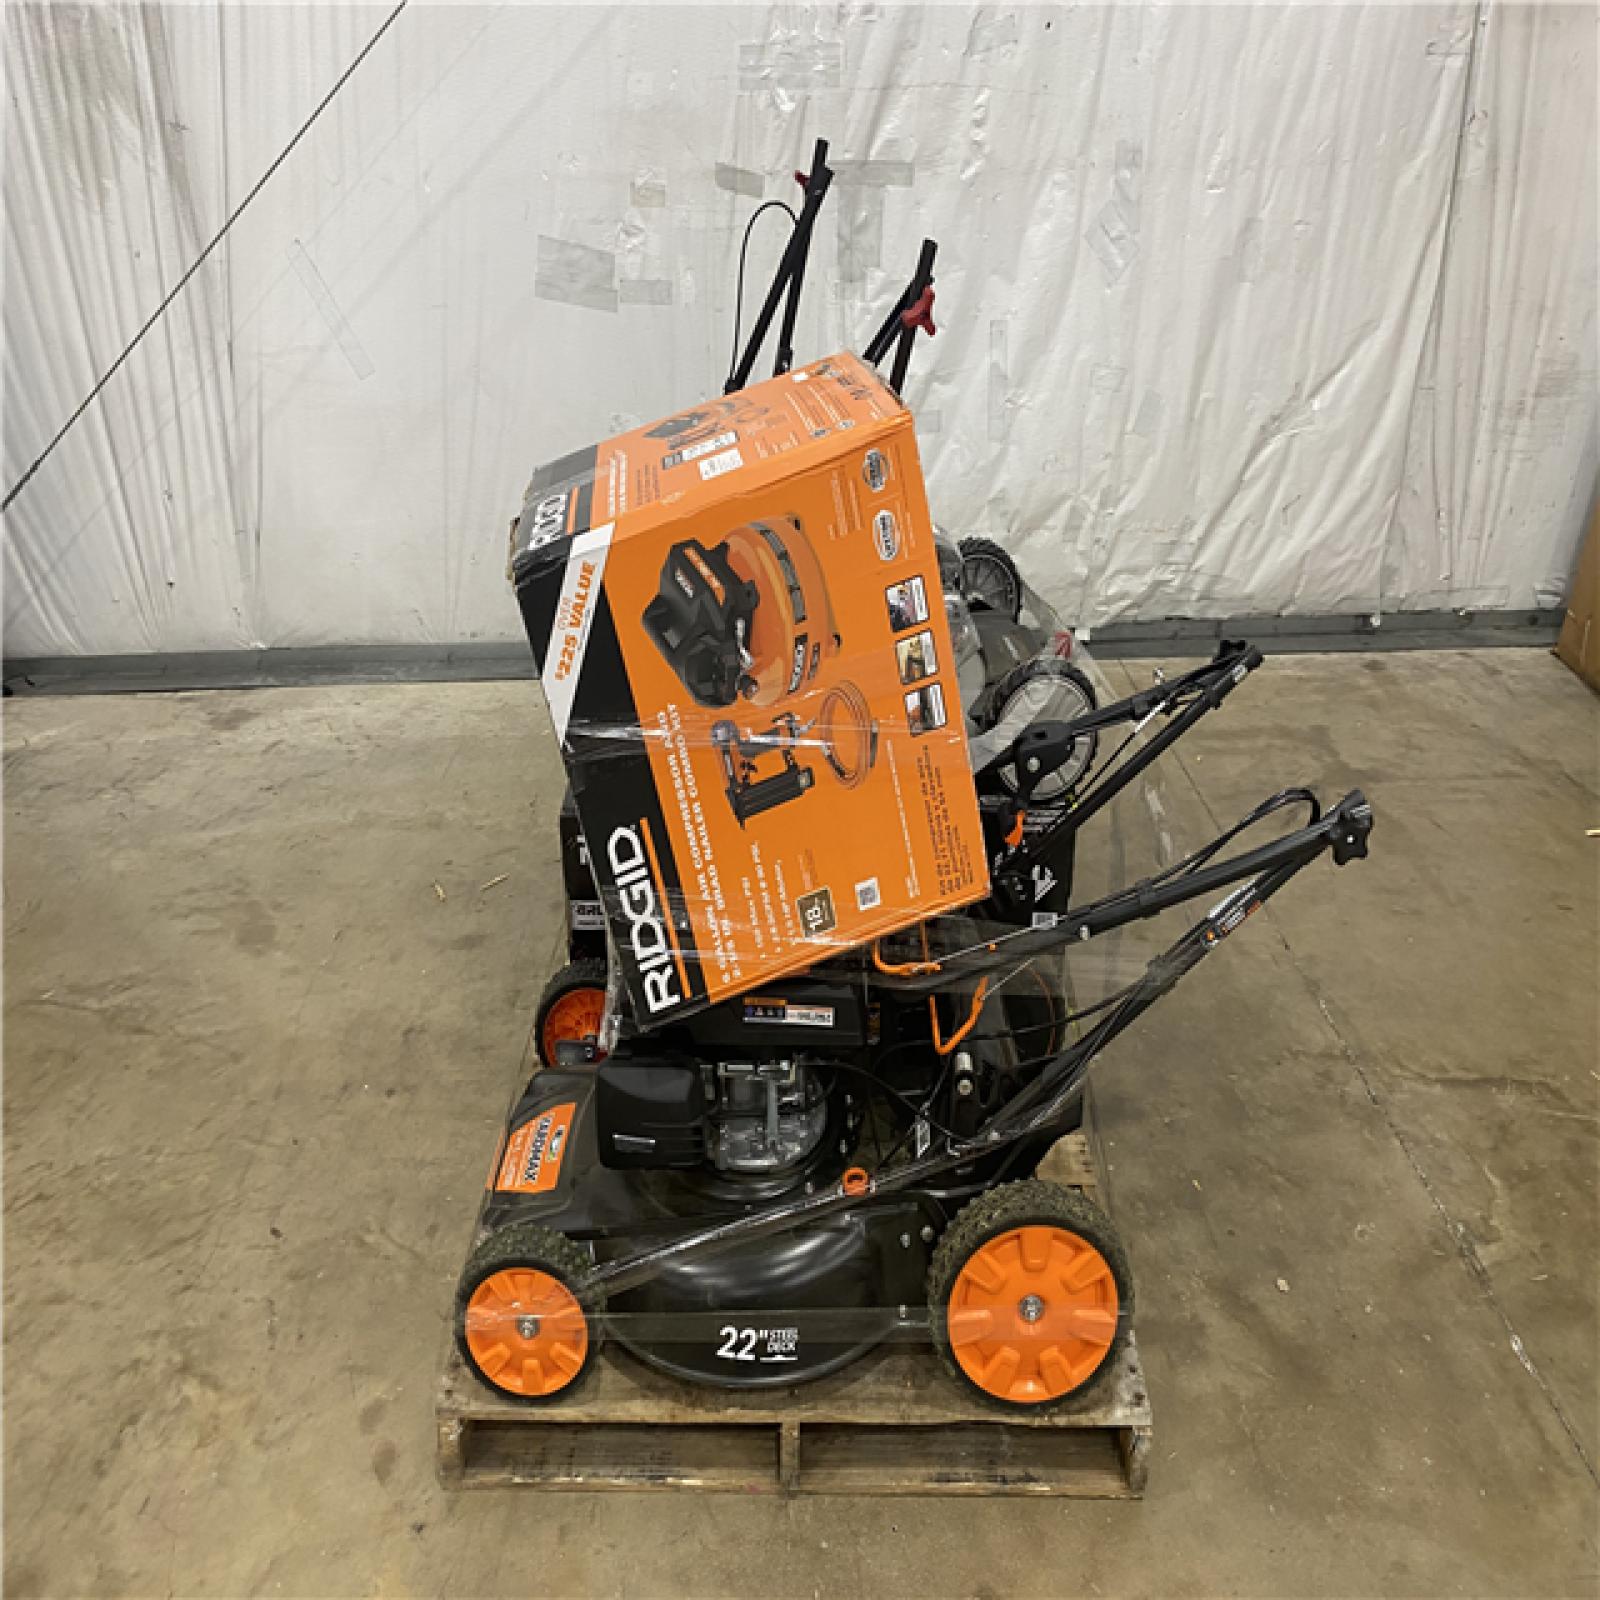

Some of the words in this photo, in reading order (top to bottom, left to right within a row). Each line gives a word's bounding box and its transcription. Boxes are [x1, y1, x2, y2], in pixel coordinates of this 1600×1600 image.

[527, 493, 566, 550] RIDGID
[569, 560, 597, 632] VALUE
[656, 709, 673, 749] AND
[666, 701, 682, 730] KIT
[674, 733, 698, 799] COMBO
[667, 751, 703, 870] COMPRESSOR
[691, 800, 714, 861] NAILER
[696, 872, 710, 901] AIR
[706, 863, 725, 910] BRAD
[608, 824, 680, 1013] RIDGID
[716, 1325, 768, 1360] 22"
